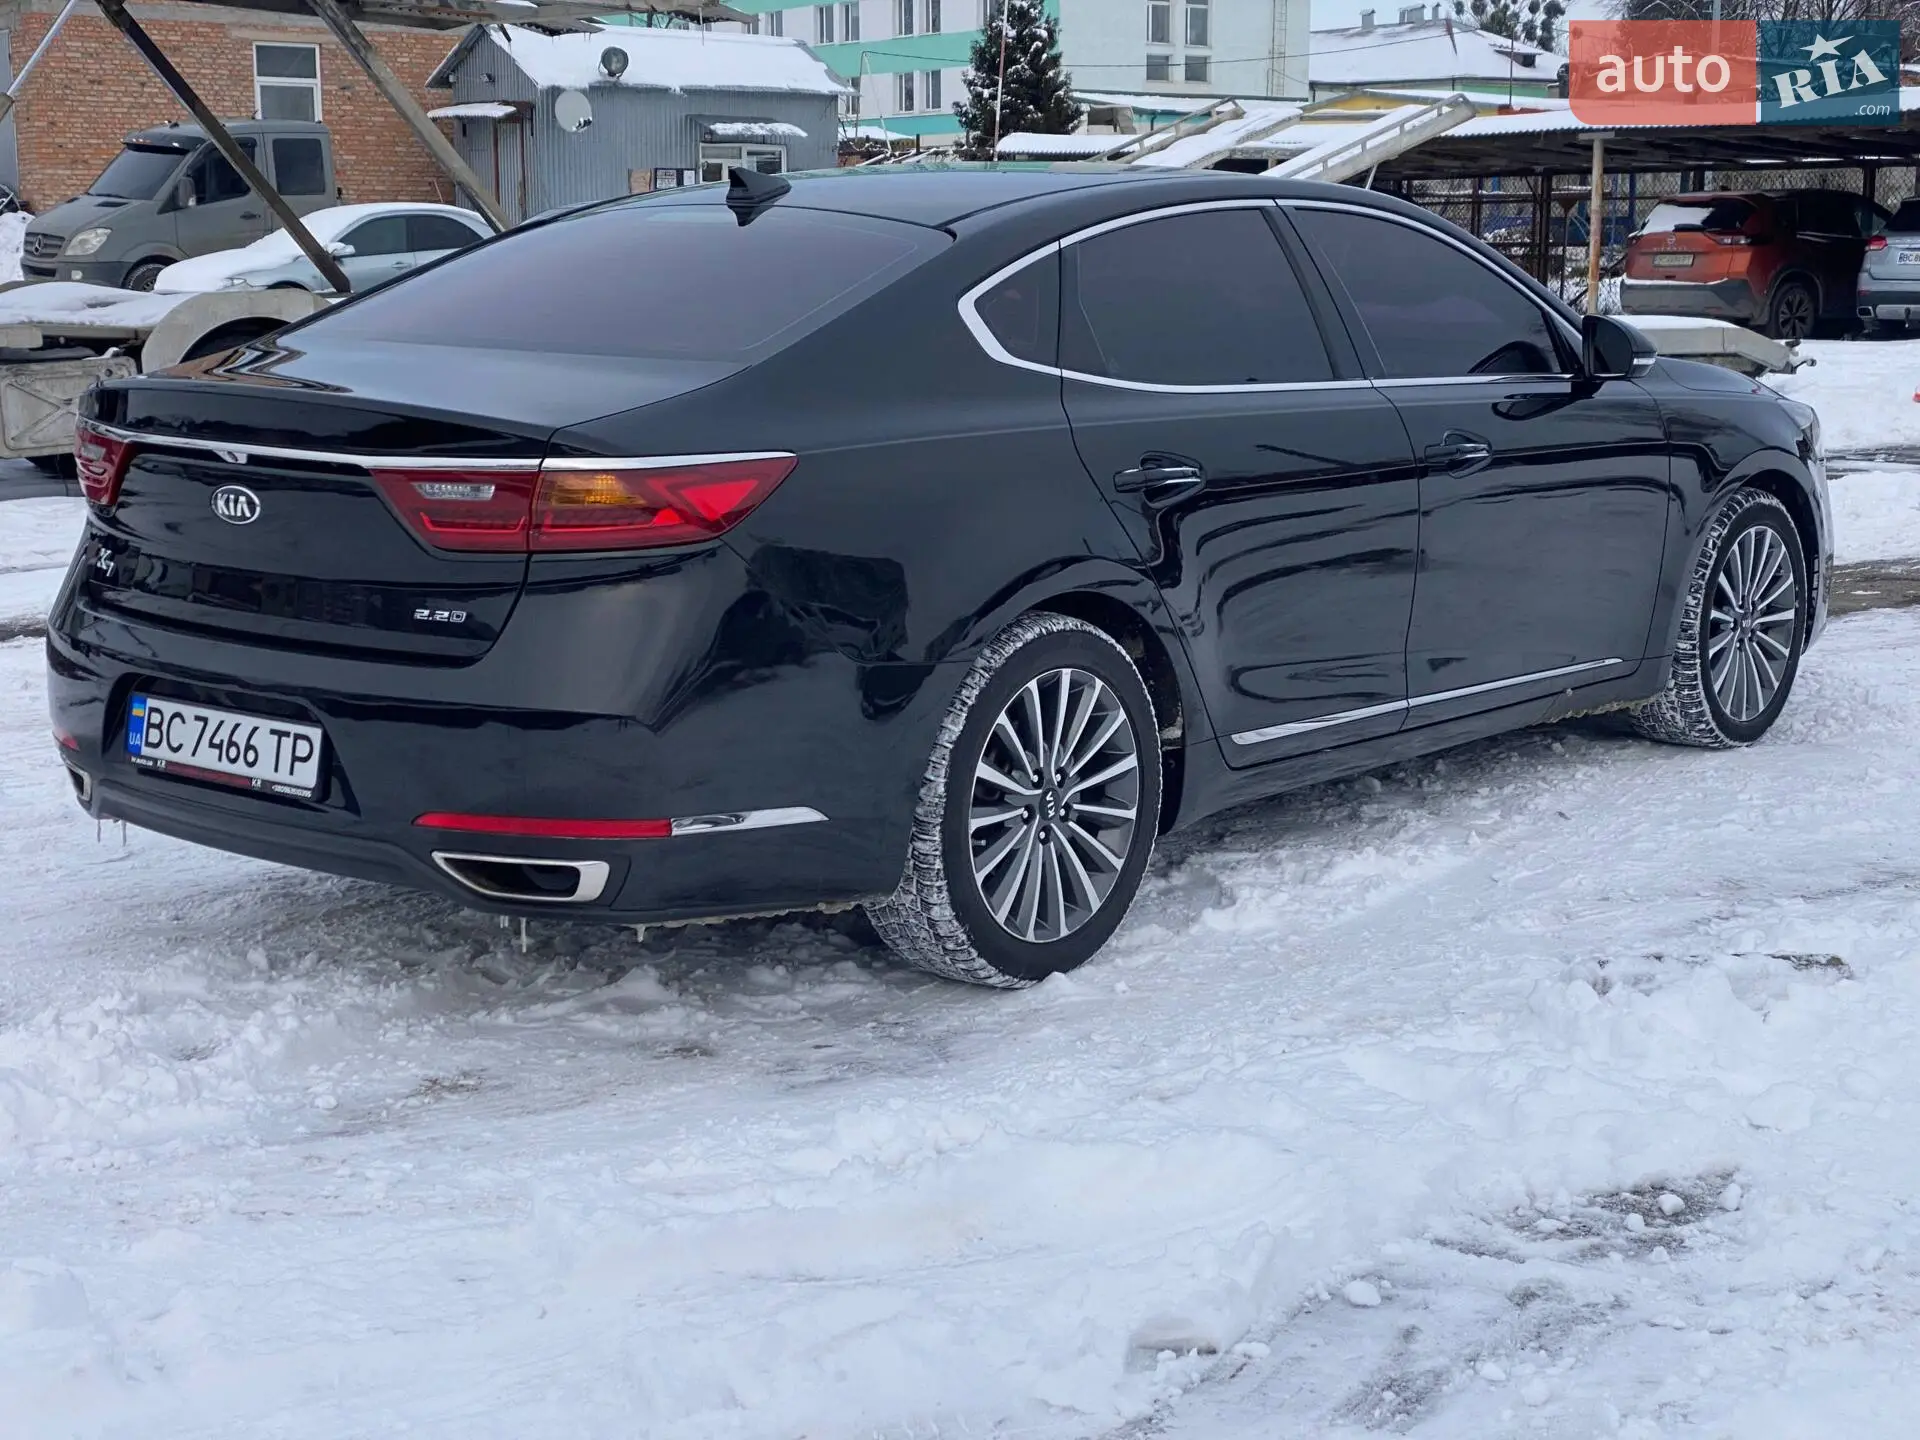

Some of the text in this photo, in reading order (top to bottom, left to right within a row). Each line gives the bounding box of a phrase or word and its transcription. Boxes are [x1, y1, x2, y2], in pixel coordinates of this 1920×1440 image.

[216, 493, 251, 518] KIA
[129, 732, 141, 746] UA
[144, 706, 314, 776] BC 7466 TP
[1046, 791, 1055, 818] KIA
